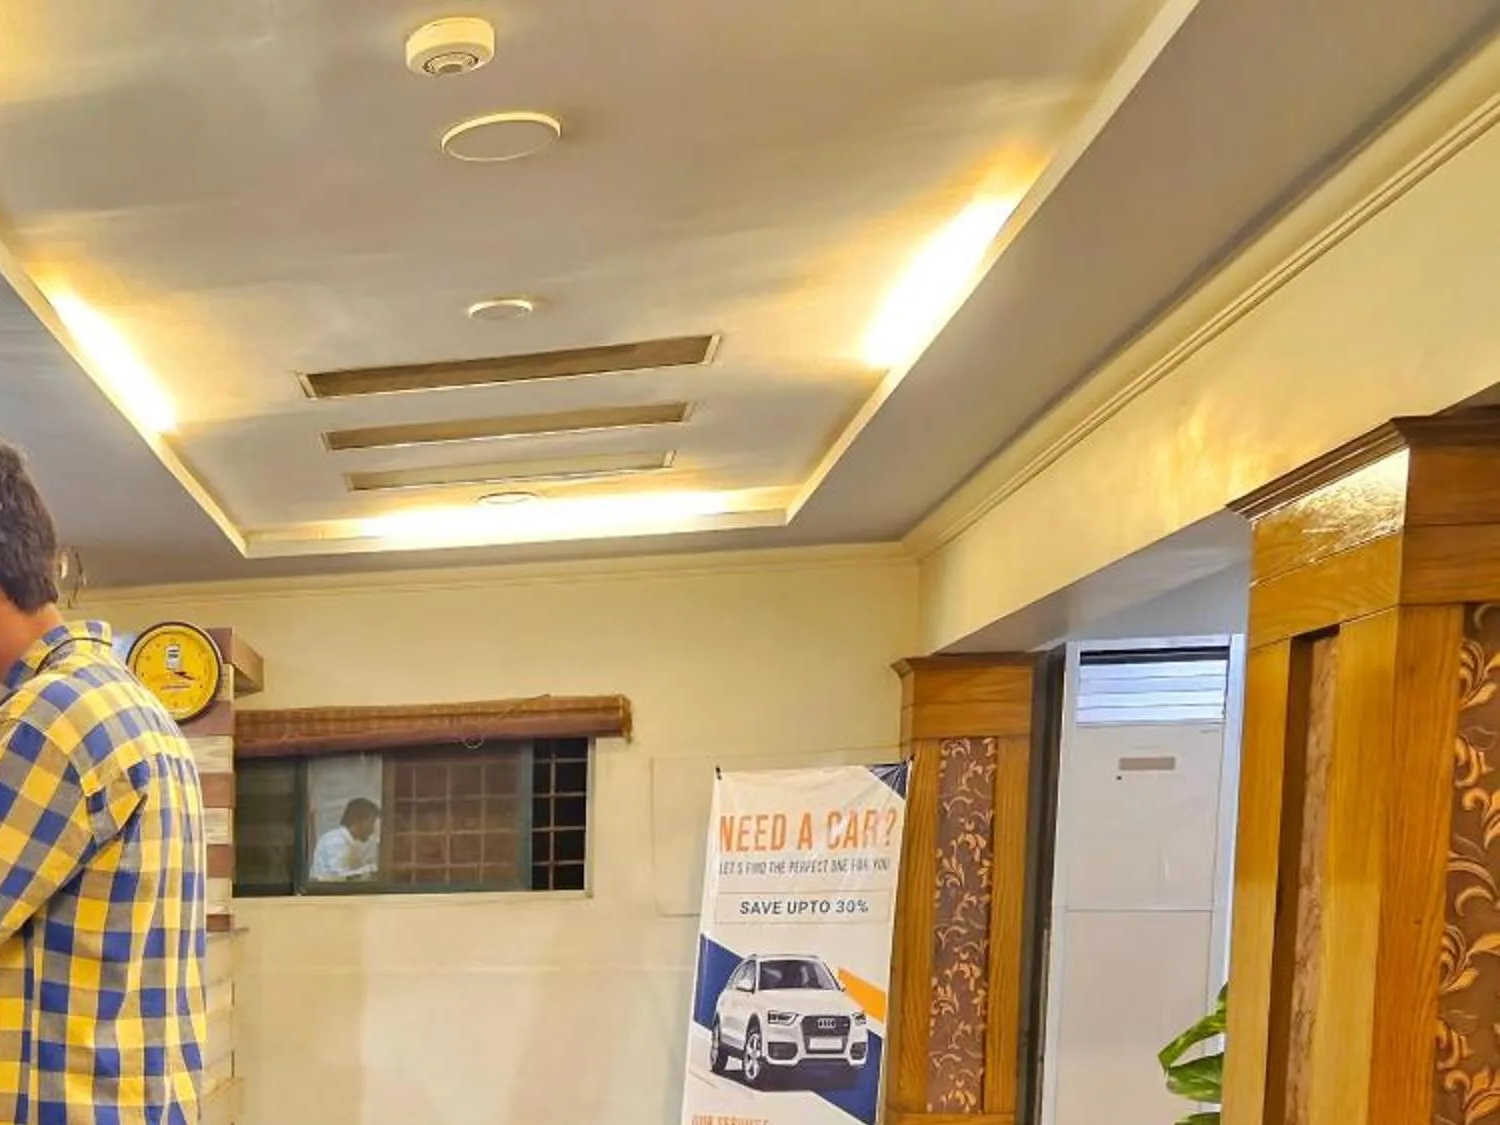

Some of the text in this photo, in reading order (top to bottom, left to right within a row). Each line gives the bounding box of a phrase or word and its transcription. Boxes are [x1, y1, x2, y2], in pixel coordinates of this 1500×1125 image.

[720, 807, 897, 852] NEED A CAR?
[768, 860, 786, 874] THE
[789, 859, 829, 874] PERFECT
[831, 858, 848, 873] ONE
[851, 858, 869, 872] FOR
[873, 857, 891, 872] YOU
[739, 899, 869, 916] SAVE UPTO 30%
